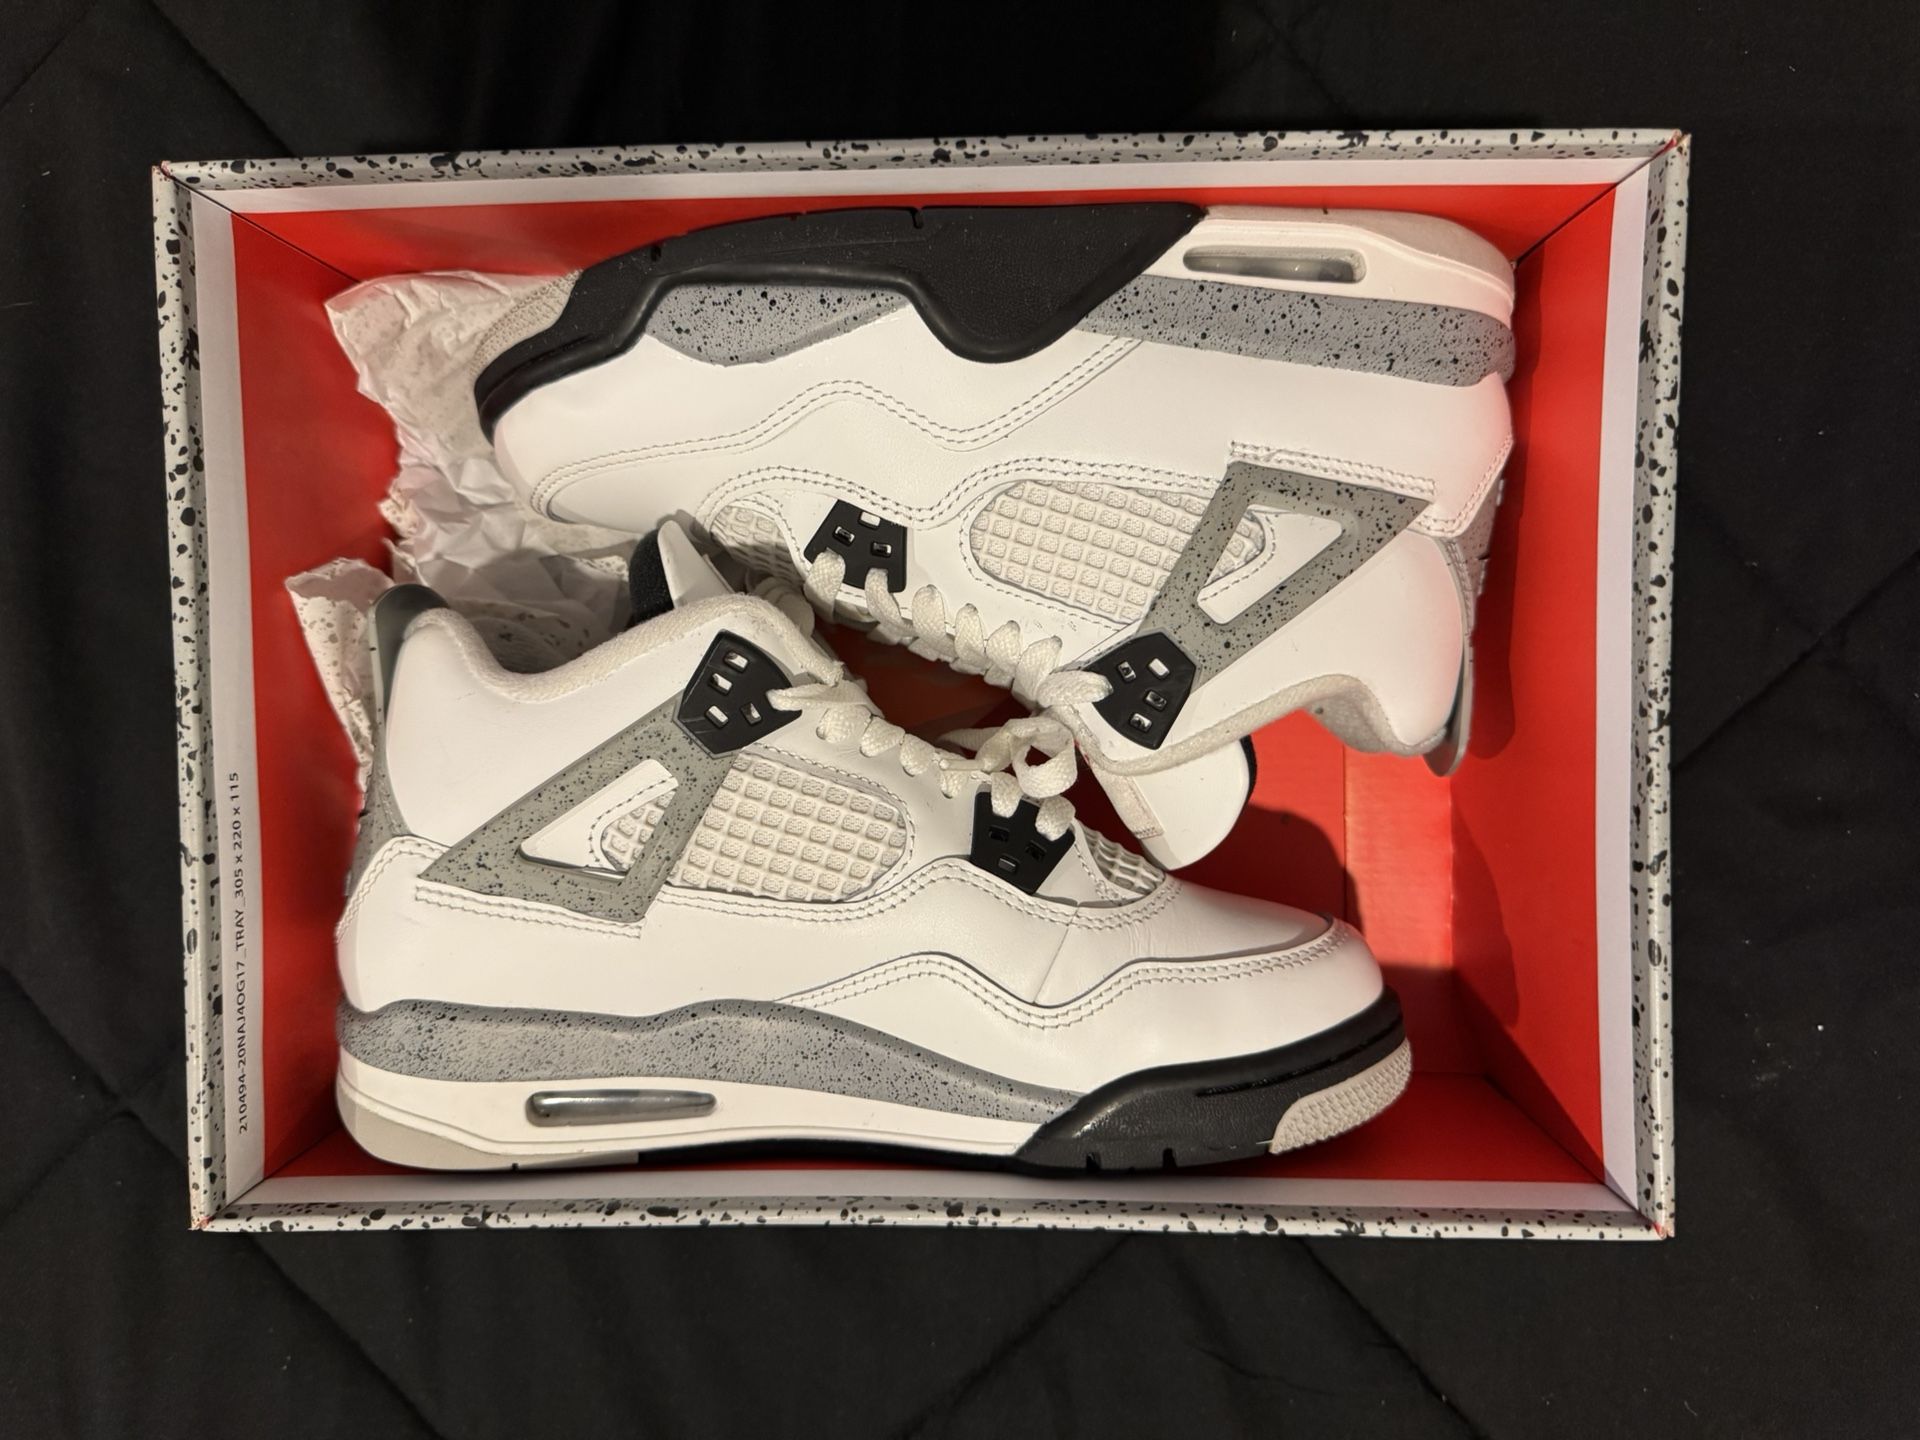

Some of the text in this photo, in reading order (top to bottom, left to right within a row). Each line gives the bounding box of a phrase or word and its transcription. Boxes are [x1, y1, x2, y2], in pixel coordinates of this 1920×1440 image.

[229, 772, 240, 801] 115
[233, 806, 241, 816] x
[232, 820, 243, 850] 220
[235, 854, 243, 864] x
